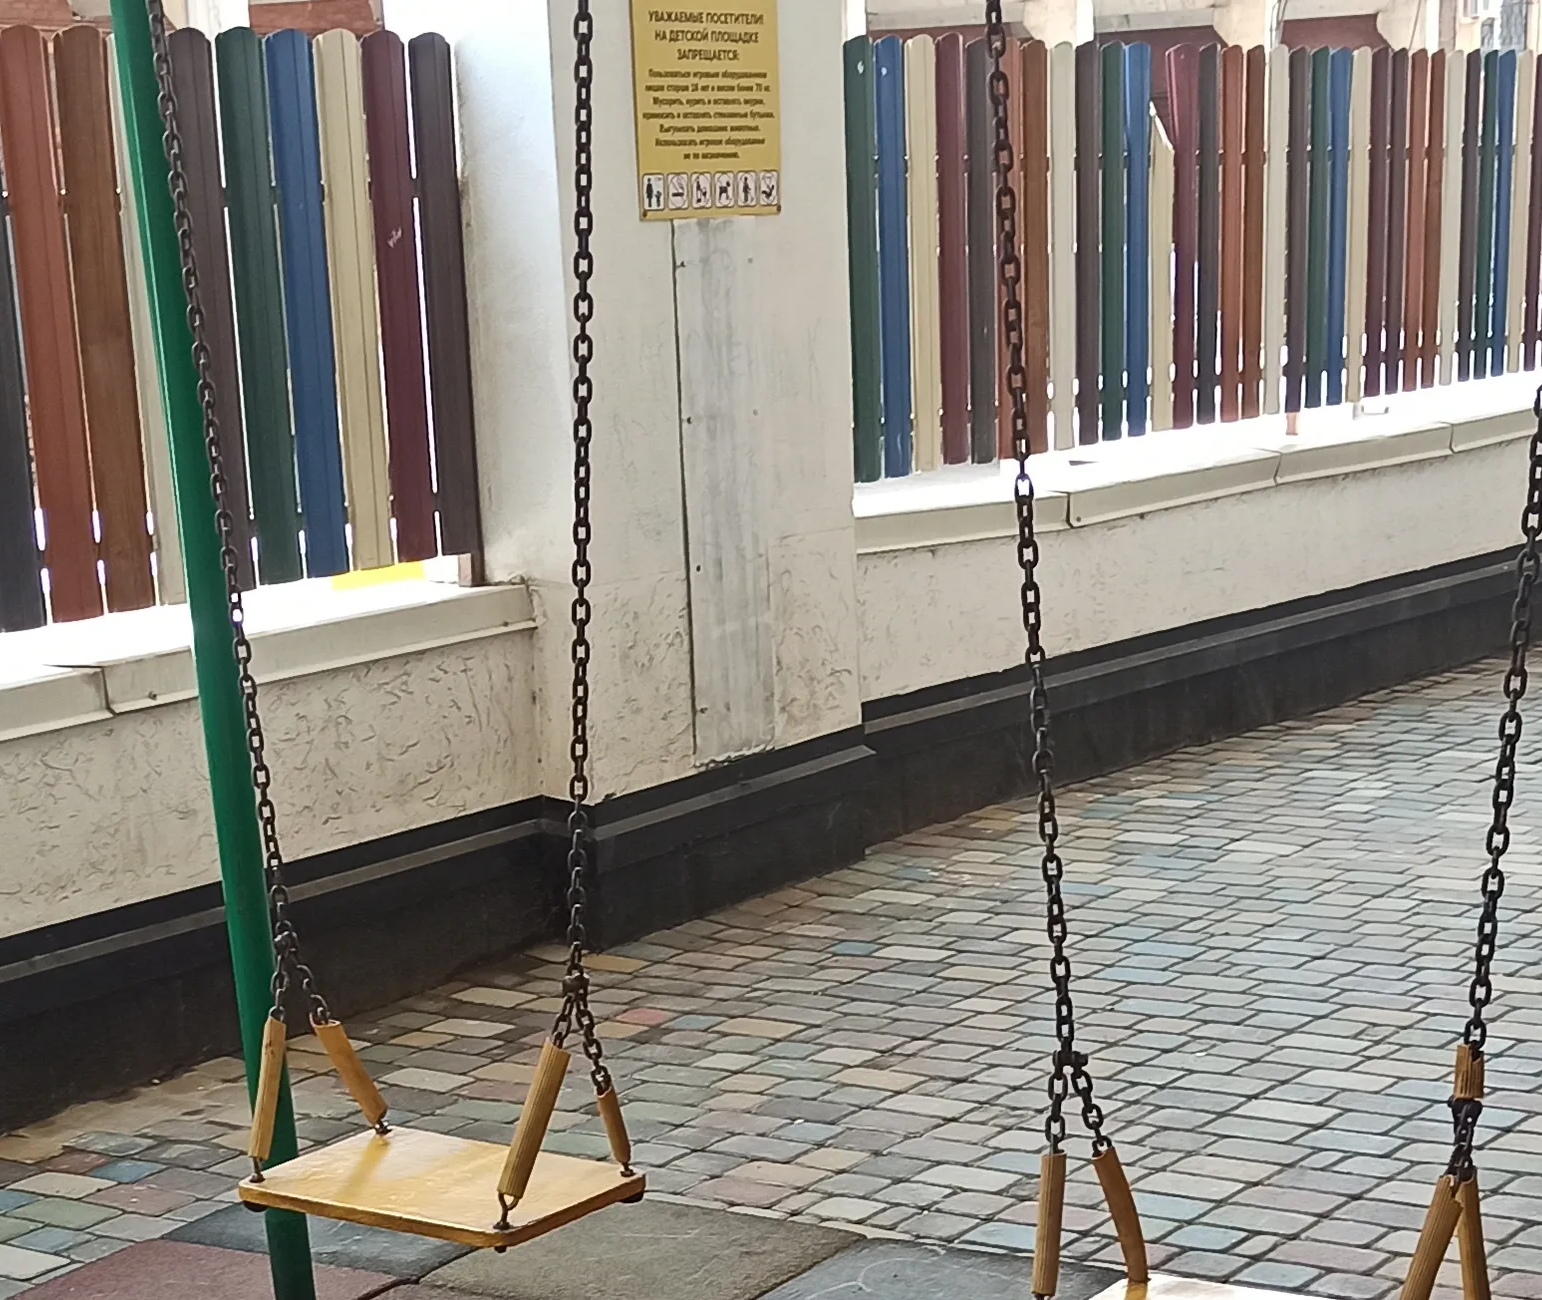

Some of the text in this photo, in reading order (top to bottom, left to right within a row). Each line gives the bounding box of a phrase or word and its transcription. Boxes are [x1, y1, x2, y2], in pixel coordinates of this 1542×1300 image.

[648, 10, 704, 24] УВАЖАЕМЫЕ
[655, 28, 759, 44] НА ДЕТСКОЙ ПЛОЩАДКЕ
